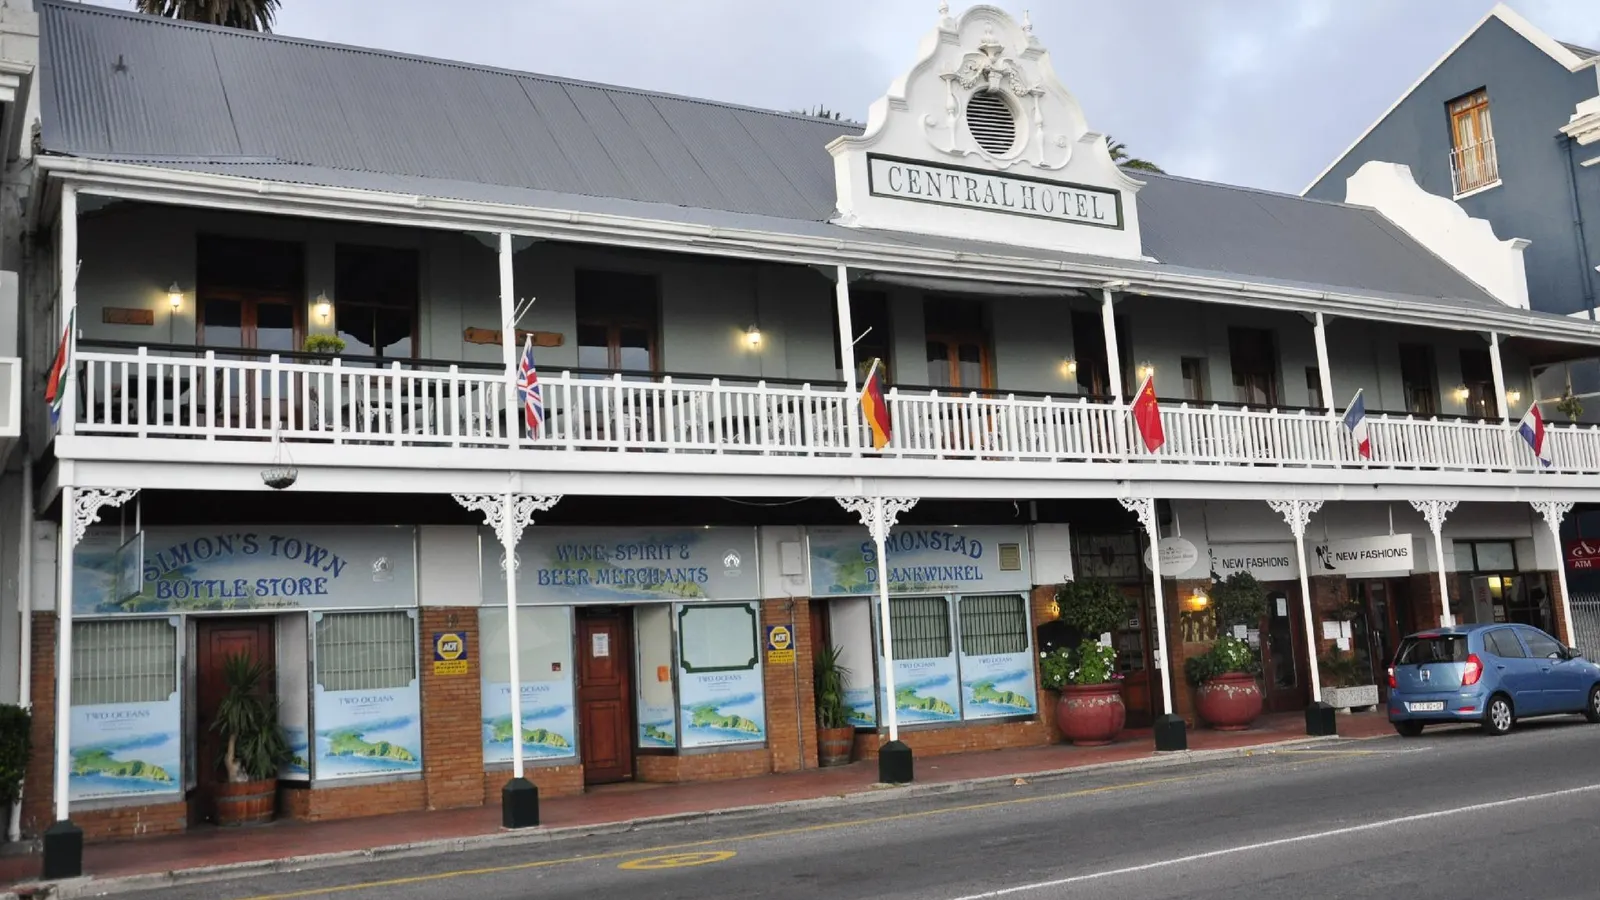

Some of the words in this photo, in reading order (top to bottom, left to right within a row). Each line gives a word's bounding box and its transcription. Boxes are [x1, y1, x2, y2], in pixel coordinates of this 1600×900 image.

[888, 166, 1014, 207] CENTRAL
[1021, 185, 1105, 220] HOTEL
[615, 543, 676, 561] SPIRIT
[861, 530, 982, 562] SMONSTAD
[1335, 551, 1358, 561] NEW
[1360, 547, 1408, 560] FASHIONS
[143, 533, 259, 582] SIMON'S
[269, 535, 347, 578] TOWN
[1222, 558, 1245, 569] NEW
[1246, 556, 1290, 569] FASHIONS
[1574, 560, 1592, 568] ATM
[537, 568, 590, 586] BEER
[595, 567, 709, 585] MERCHANTS
[866, 565, 984, 583] DANKWINKEL
[156, 579, 248, 599] BOTTLE
[255, 577, 329, 597] STORE
[443, 642, 458, 651] ADT
[520, 685, 550, 693] OCEANS
[339, 696, 359, 705] TWO
[360, 694, 395, 704] OCEANS
[86, 711, 109, 721] TWO
[111, 709, 150, 719] OCEANS
